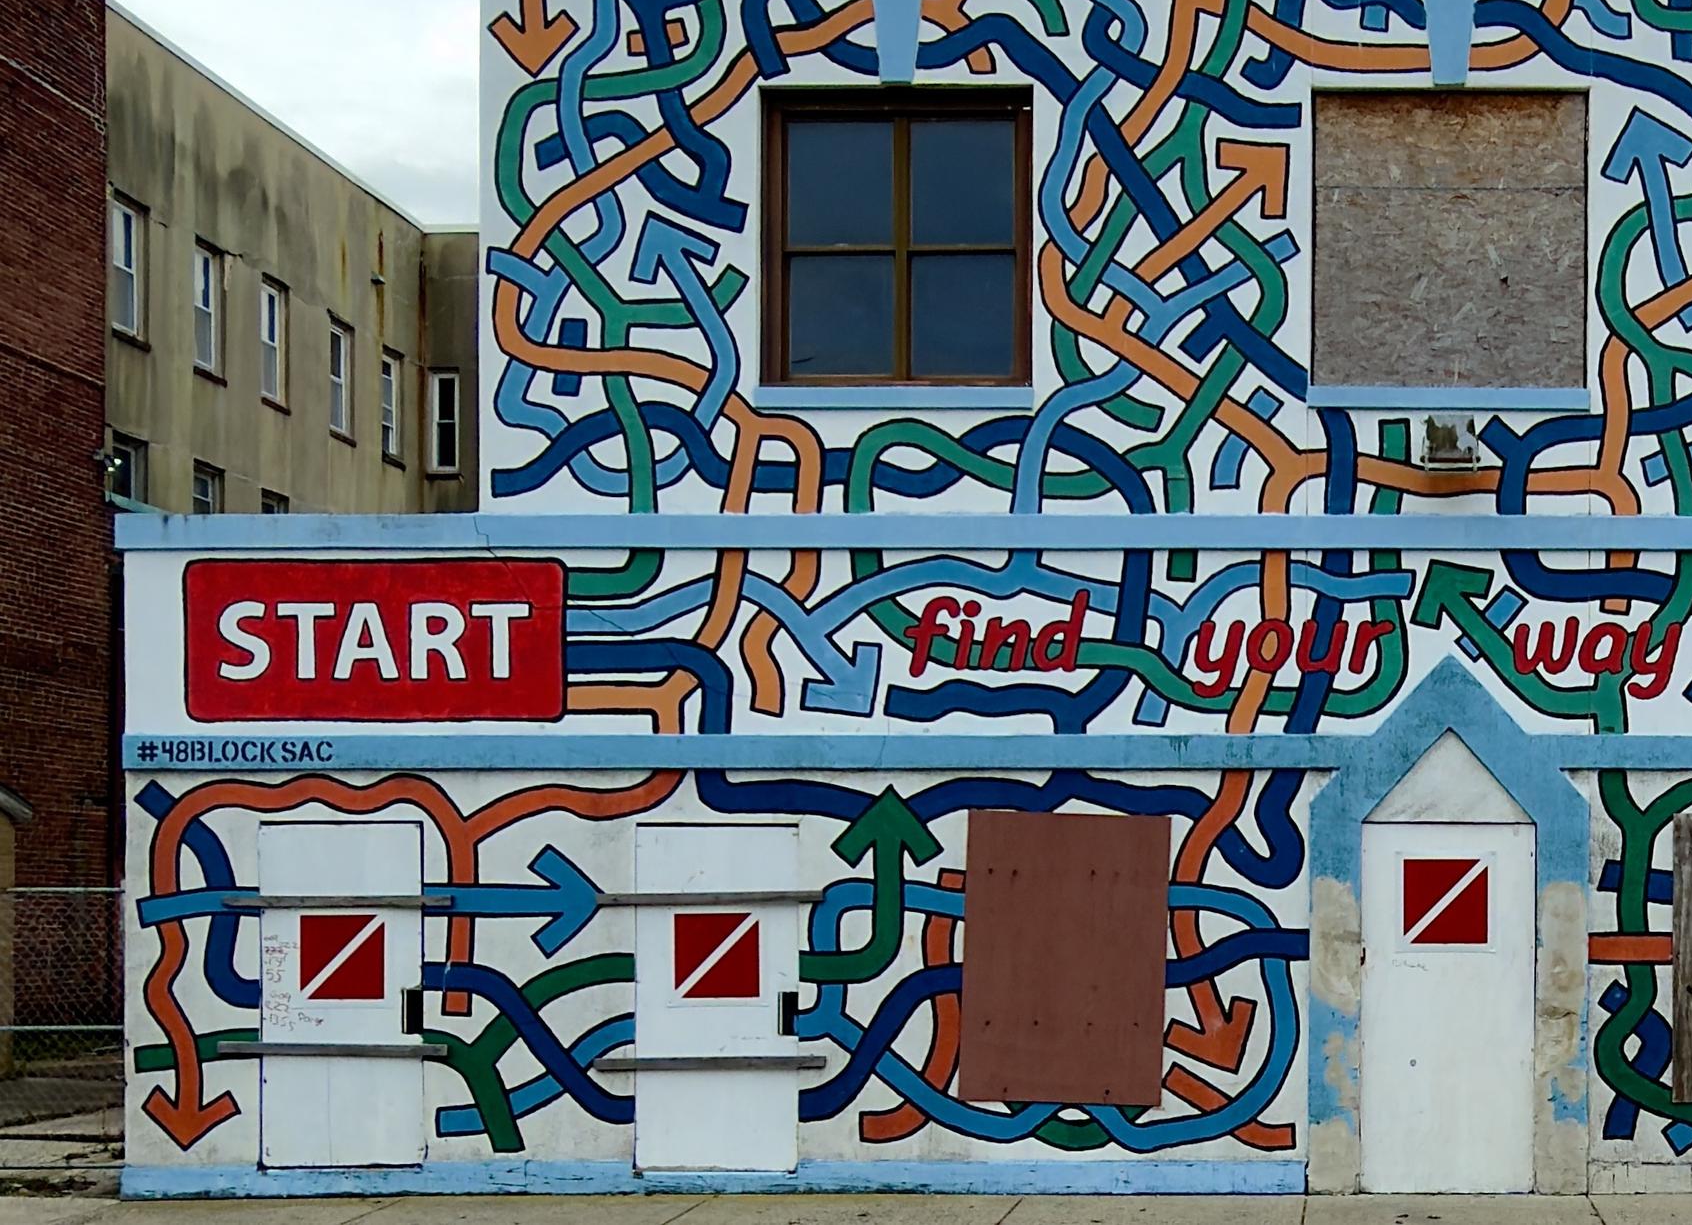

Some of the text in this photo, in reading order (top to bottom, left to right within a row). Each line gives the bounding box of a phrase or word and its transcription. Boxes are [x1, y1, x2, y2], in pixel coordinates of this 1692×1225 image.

[218, 600, 531, 681] START
[904, 590, 1682, 699] find your way
